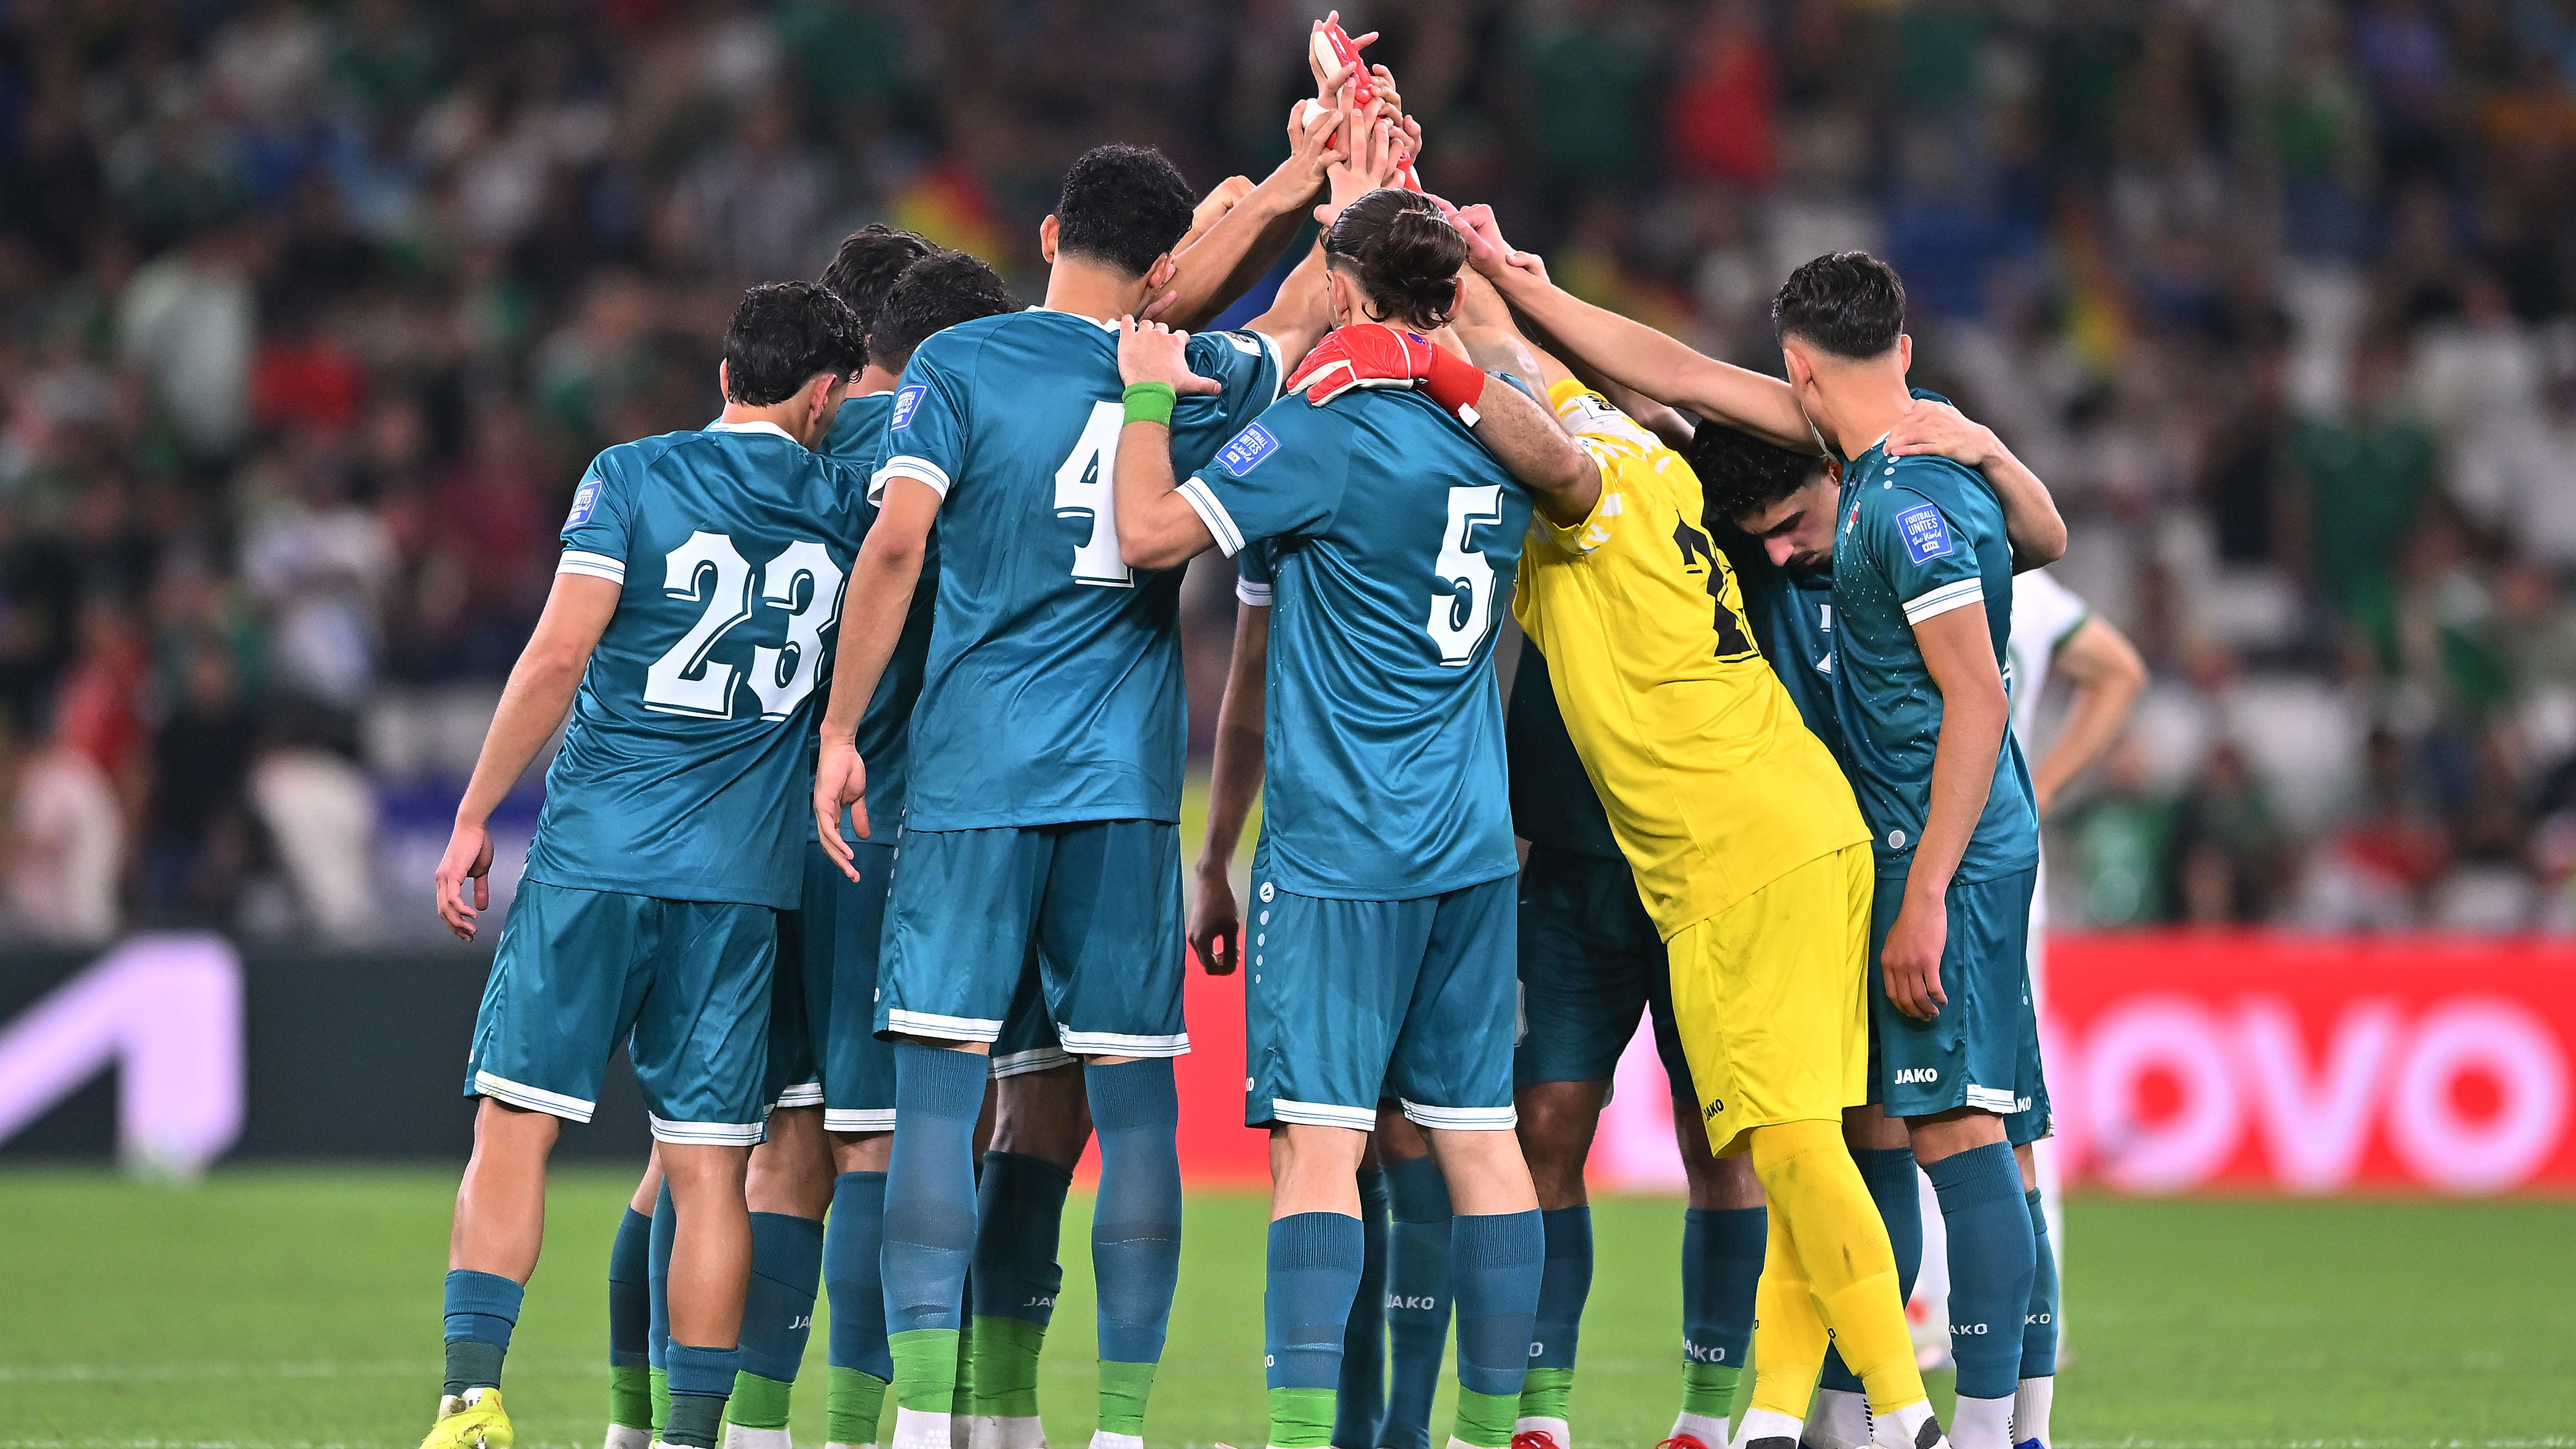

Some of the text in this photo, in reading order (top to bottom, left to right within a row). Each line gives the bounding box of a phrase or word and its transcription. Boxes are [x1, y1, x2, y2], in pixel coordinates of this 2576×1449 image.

[1055, 400, 1134, 588] 4
[1905, 510, 1936, 526] FOOTBALL
[1907, 517, 1938, 536] UNITES
[1911, 528, 1942, 546] the World
[1427, 485, 1504, 666] 5
[1672, 515, 1761, 664] 2
[643, 531, 846, 722] 23
[1895, 1068, 1938, 1085] JAKO
[2044, 994, 2566, 1194] OVO
[1703, 1099, 1724, 1122] JAKO
[2013, 1096, 2031, 1113] KO
[1023, 1297, 1055, 1308] JA
[788, 1316, 809, 1329] JA
[2025, 1314, 2050, 1324] KO
[1950, 1324, 1988, 1335] AKO
[1683, 1336, 1725, 1362] AKO
